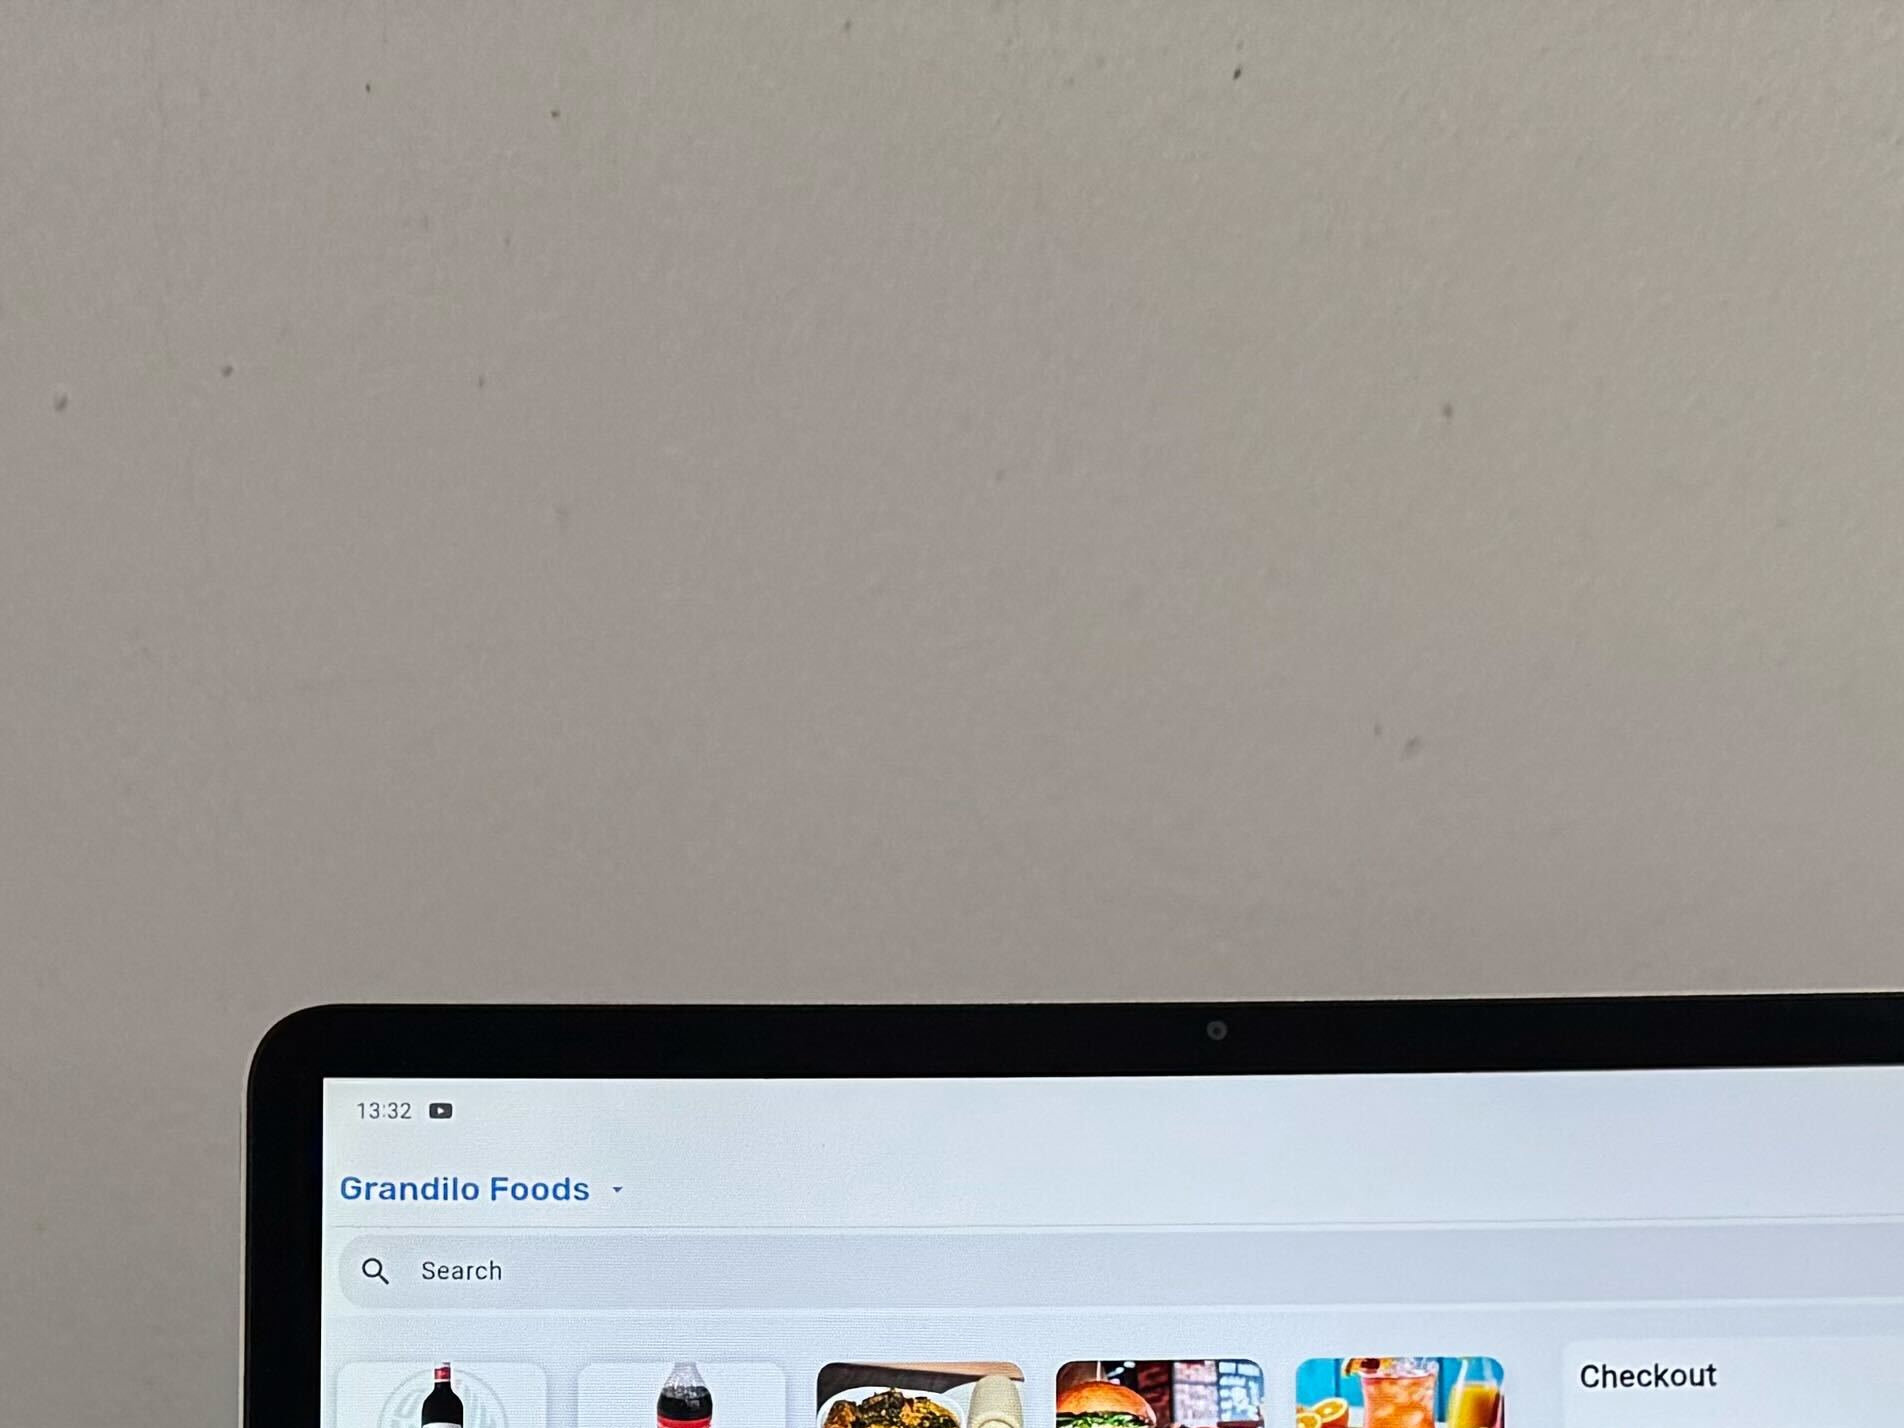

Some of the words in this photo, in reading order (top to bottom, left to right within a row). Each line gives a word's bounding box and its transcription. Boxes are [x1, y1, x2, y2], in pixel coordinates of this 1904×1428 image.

[358, 1102, 411, 1119] 13:32
[341, 1177, 479, 1200] Grandilo
[491, 1177, 589, 1201] Foods
[422, 1260, 501, 1280] Search
[1581, 1363, 1717, 1388] Checkout
